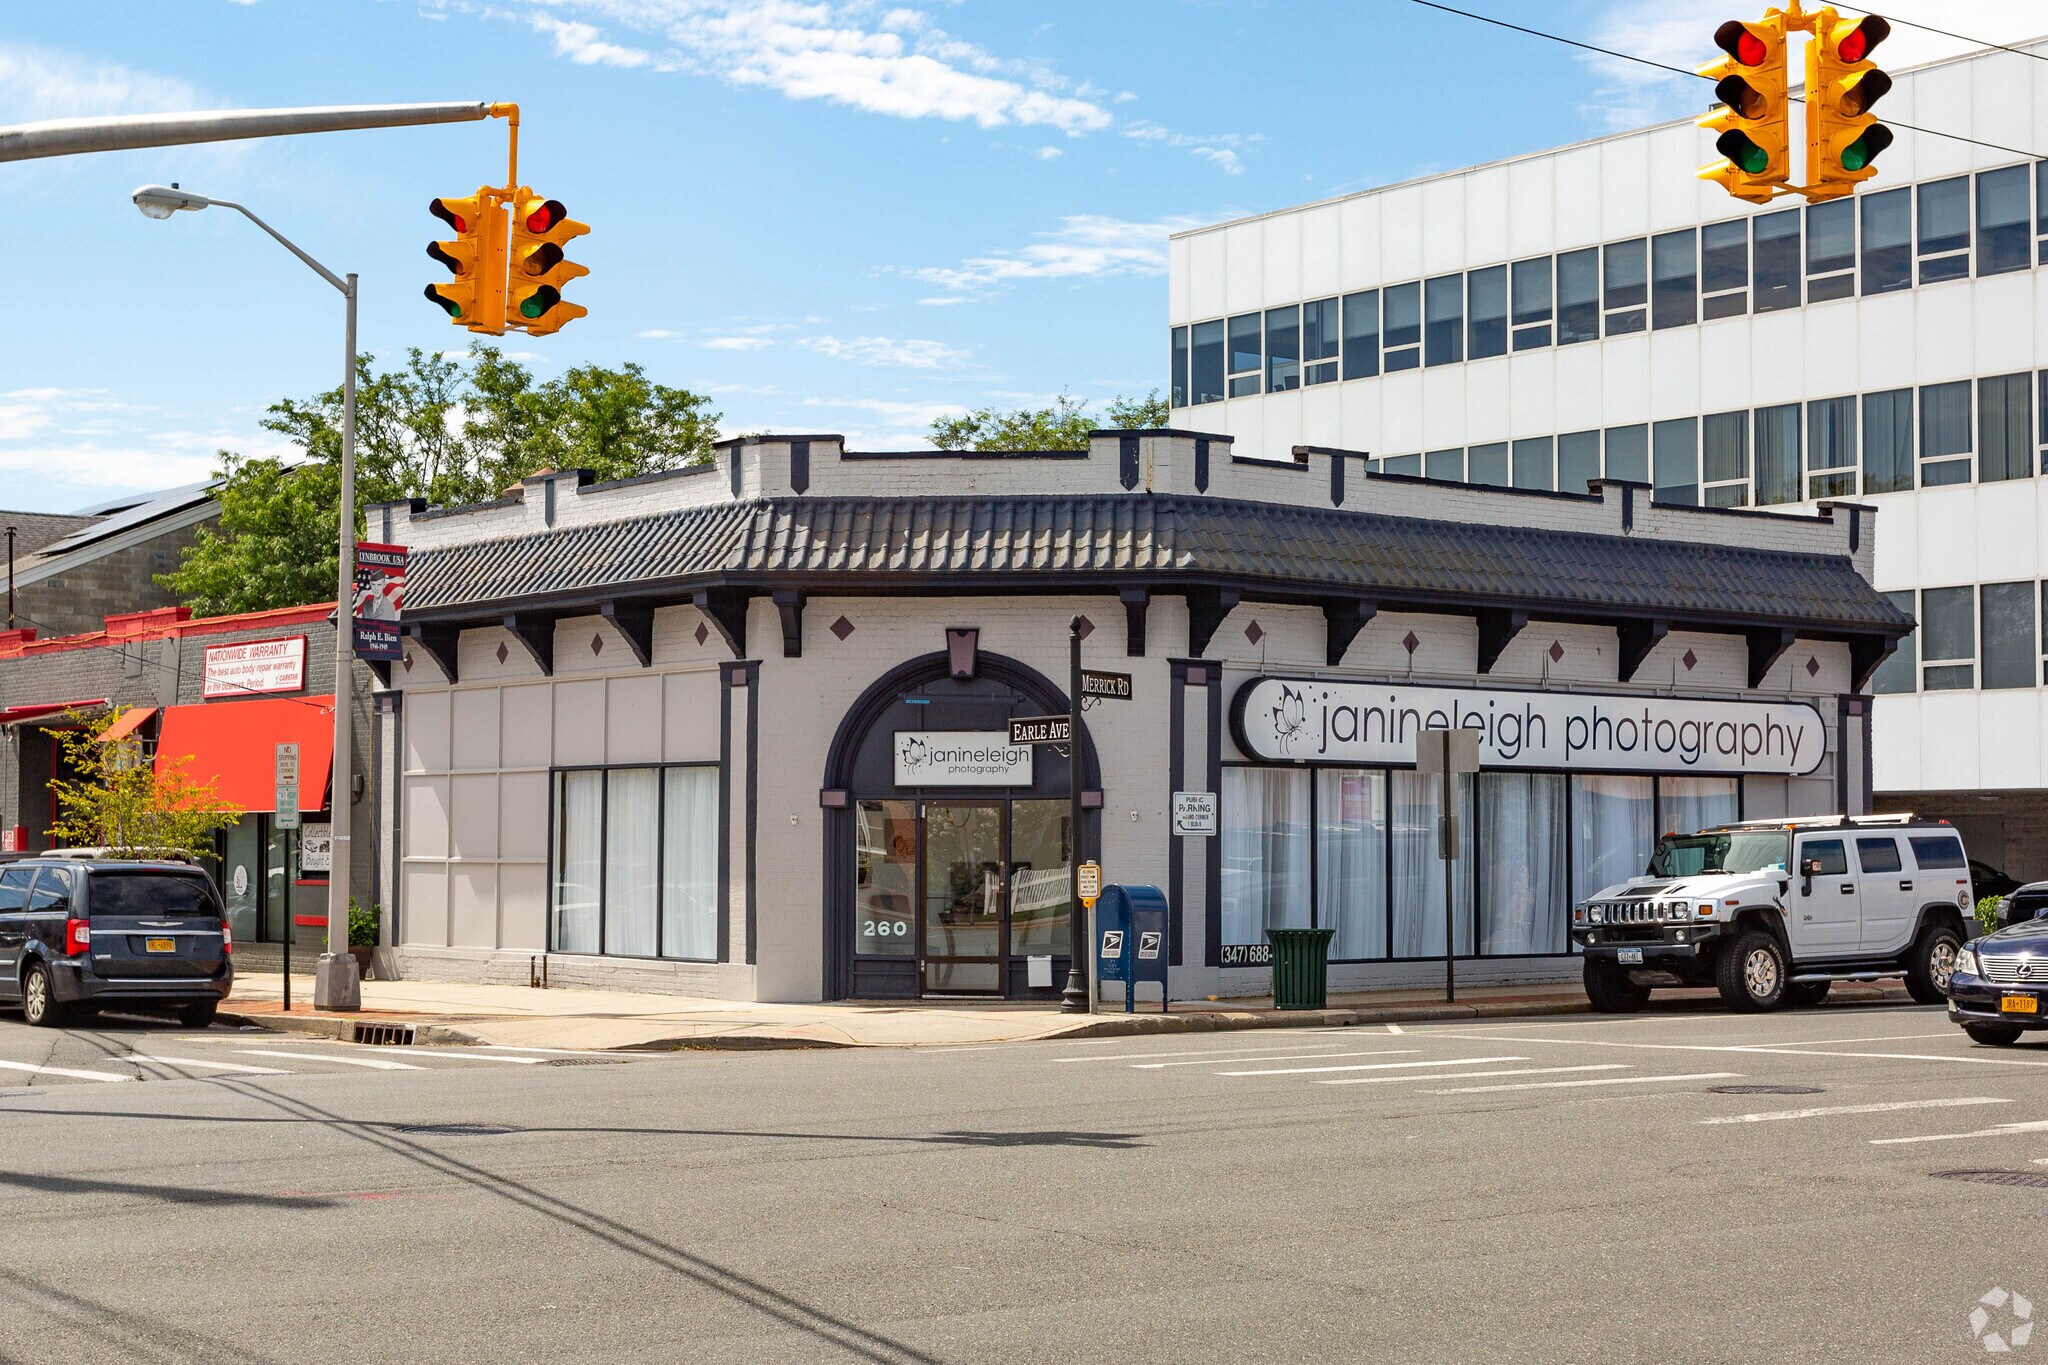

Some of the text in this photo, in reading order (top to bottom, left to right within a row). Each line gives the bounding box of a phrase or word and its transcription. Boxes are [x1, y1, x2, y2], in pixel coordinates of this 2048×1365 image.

[359, 551, 405, 565] LYNBROOK USA
[360, 630, 398, 642] Ralph E. Bien
[208, 643, 289, 663] NATIONWIDE WARRANTY
[208, 660, 297, 677] The best auto body repair warranty
[279, 673, 299, 682] CARSTAR
[1082, 674, 1117, 694] MERRICK
[207, 683, 212, 692] in
[212, 682, 221, 691] the
[1013, 721, 1070, 741] EARLE AVE
[1318, 691, 1804, 767] janineleigh photography
[283, 746, 292, 754] NO
[928, 746, 1029, 775] janineleigh photography
[306, 854, 324, 868] Bought
[863, 920, 907, 937] 260
[1221, 945, 1273, 963] (347) 688-
